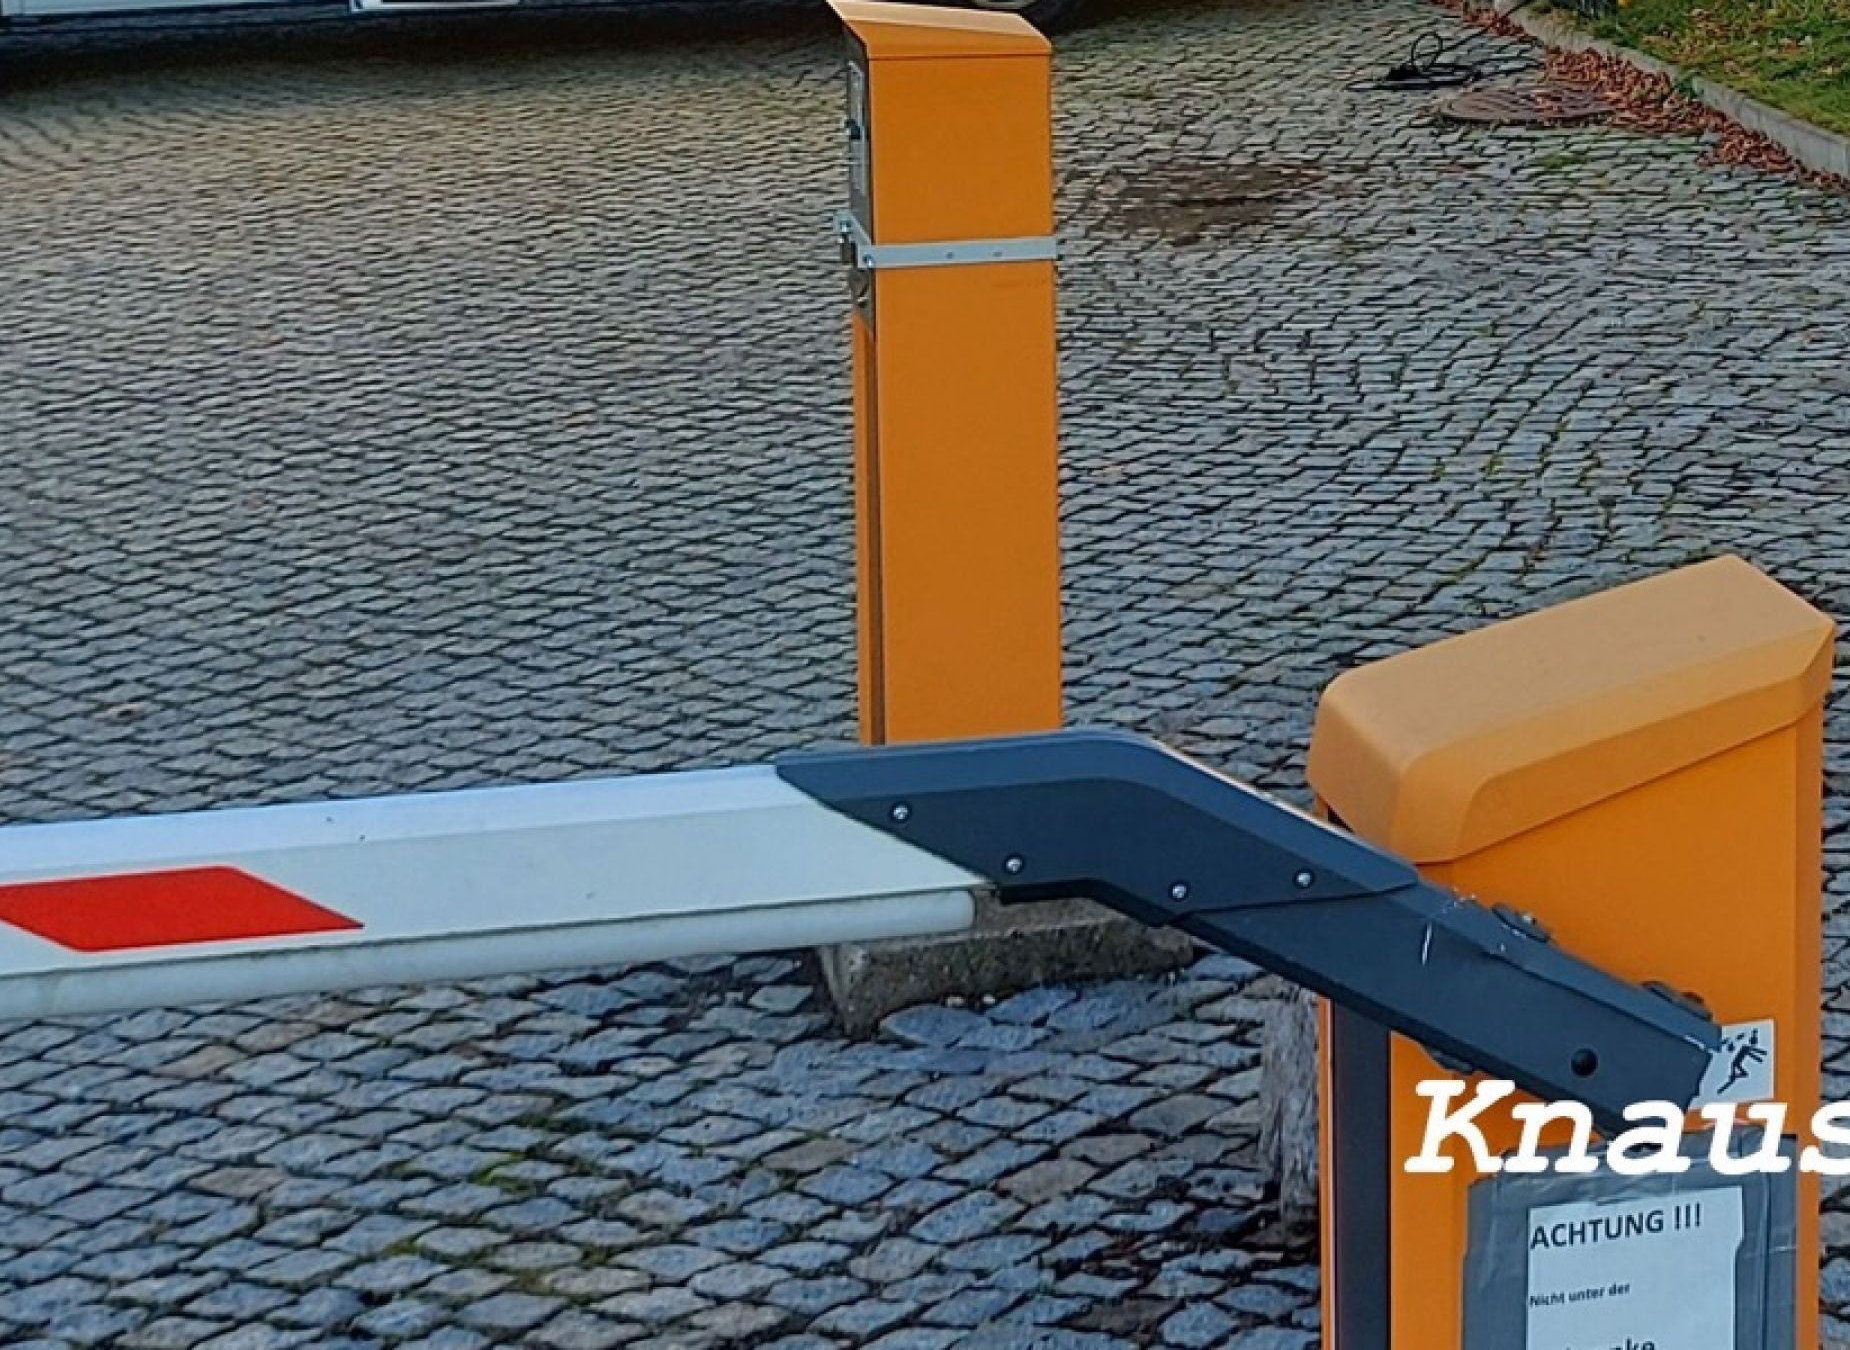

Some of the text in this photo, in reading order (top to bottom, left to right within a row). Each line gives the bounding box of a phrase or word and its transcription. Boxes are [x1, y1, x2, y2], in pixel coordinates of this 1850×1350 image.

[1530, 1209, 1665, 1250] ACHTUNG
[1530, 1283, 1631, 1308] Nicht unter der
